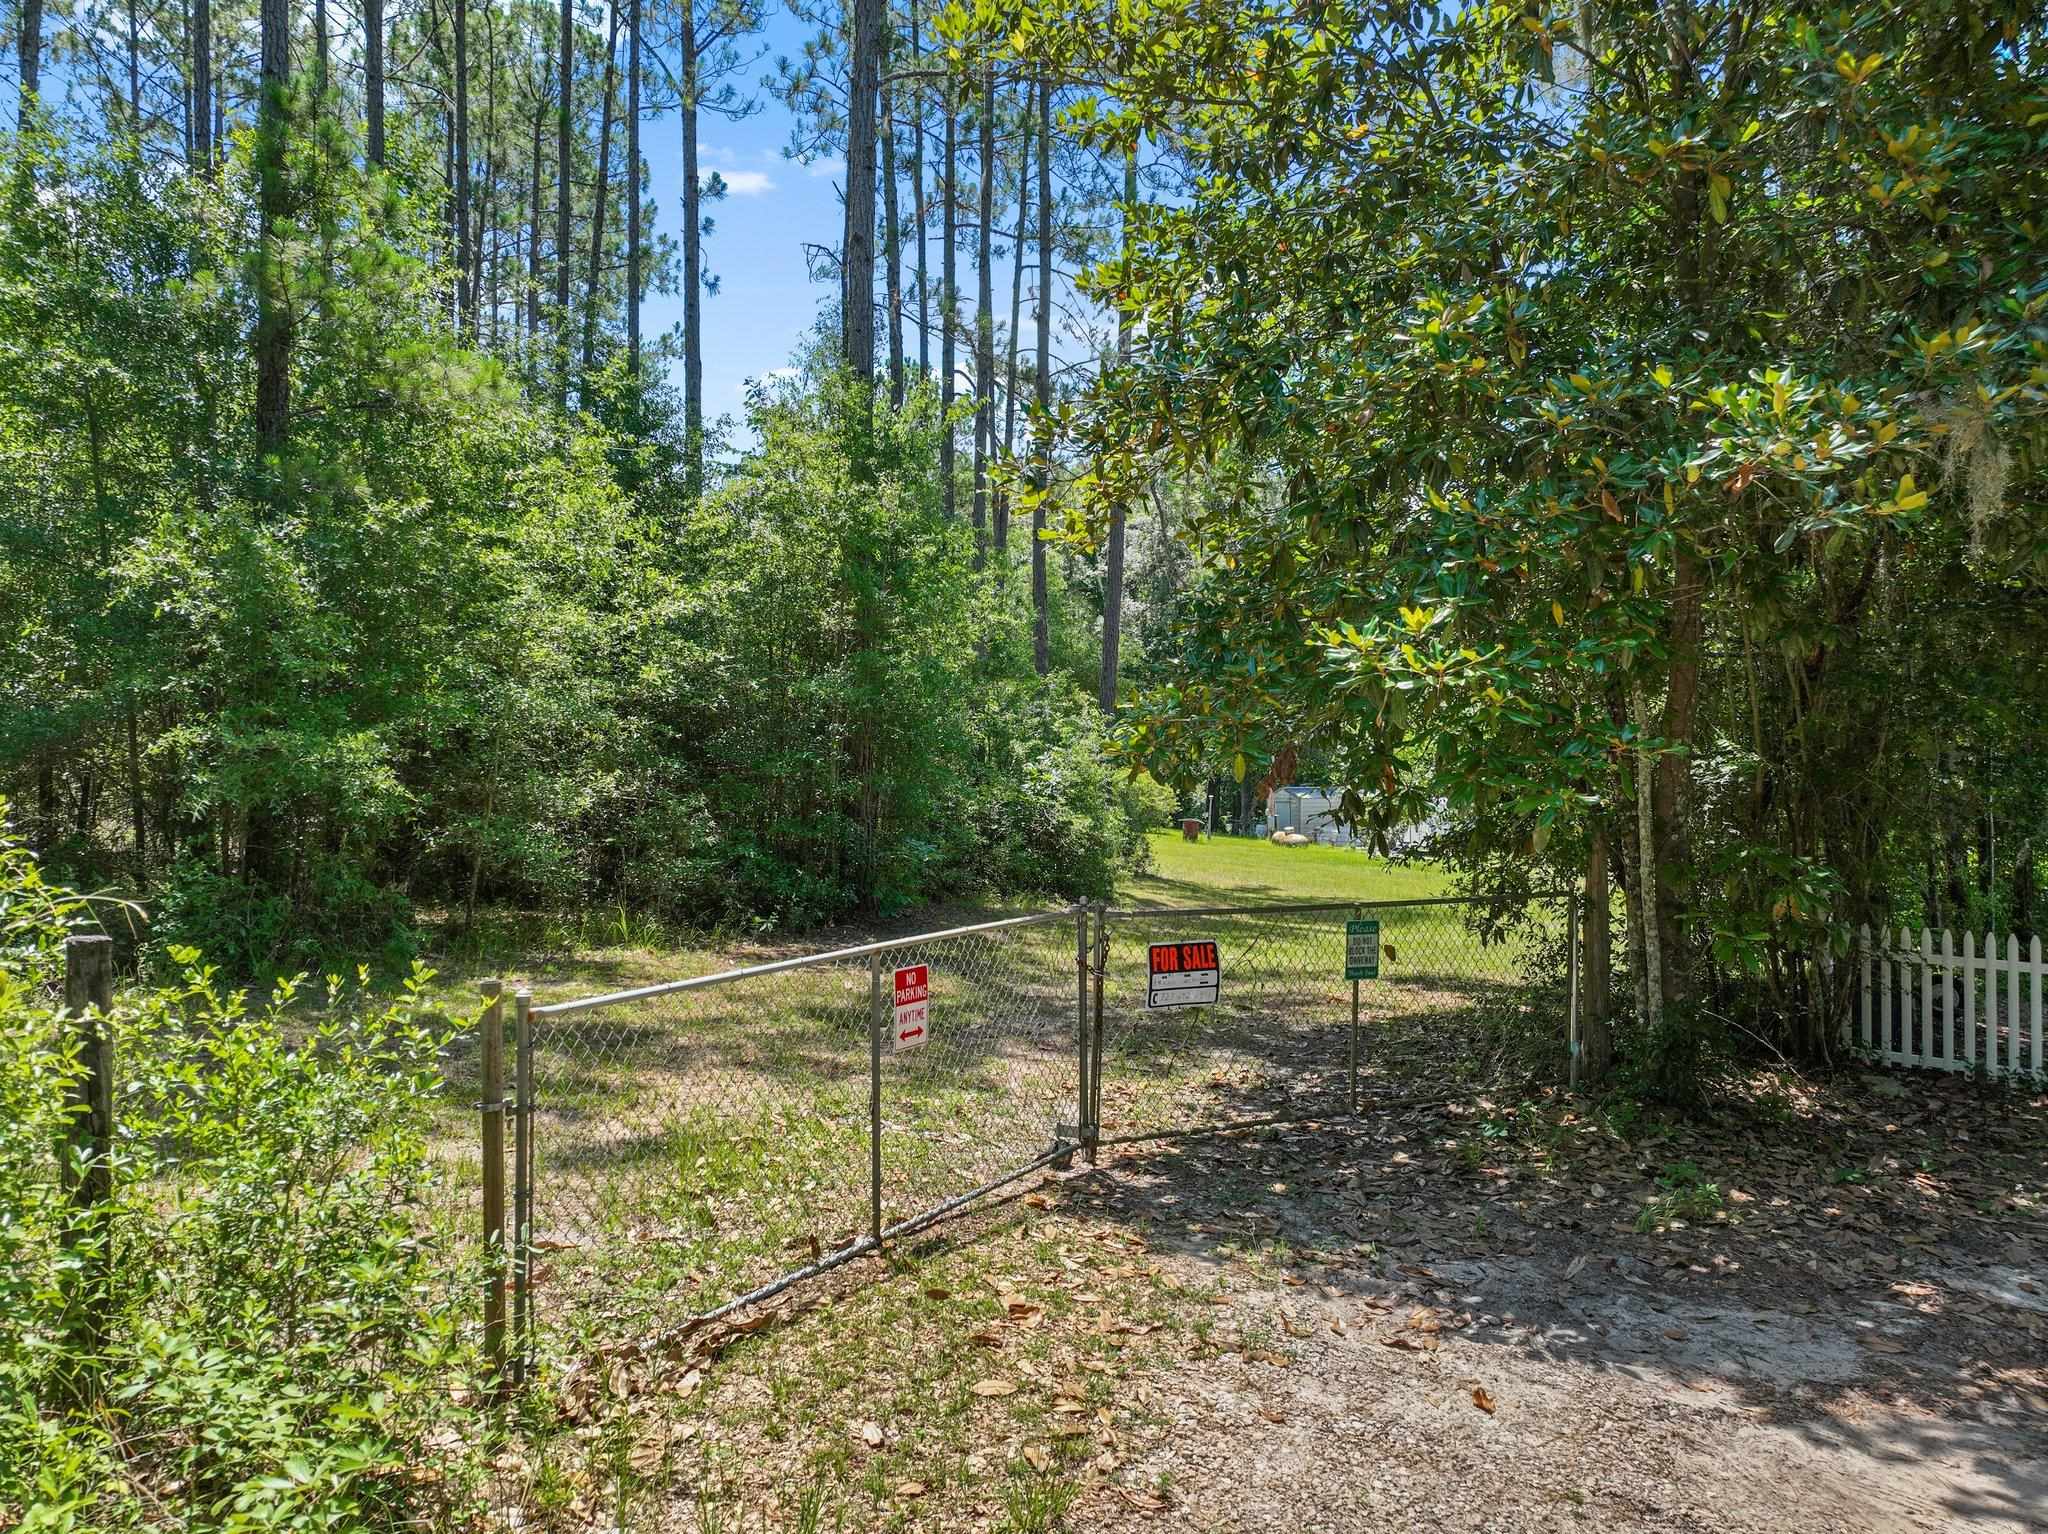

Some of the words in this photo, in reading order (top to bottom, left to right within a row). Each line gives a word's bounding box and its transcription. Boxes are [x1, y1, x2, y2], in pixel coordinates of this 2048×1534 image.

[1152, 946, 1178, 972] FOR
[1182, 944, 1216, 970] SALE
[906, 972, 916, 986] NO
[897, 984, 927, 1004] PARKING
[900, 1008, 925, 1024] ANYTIME
